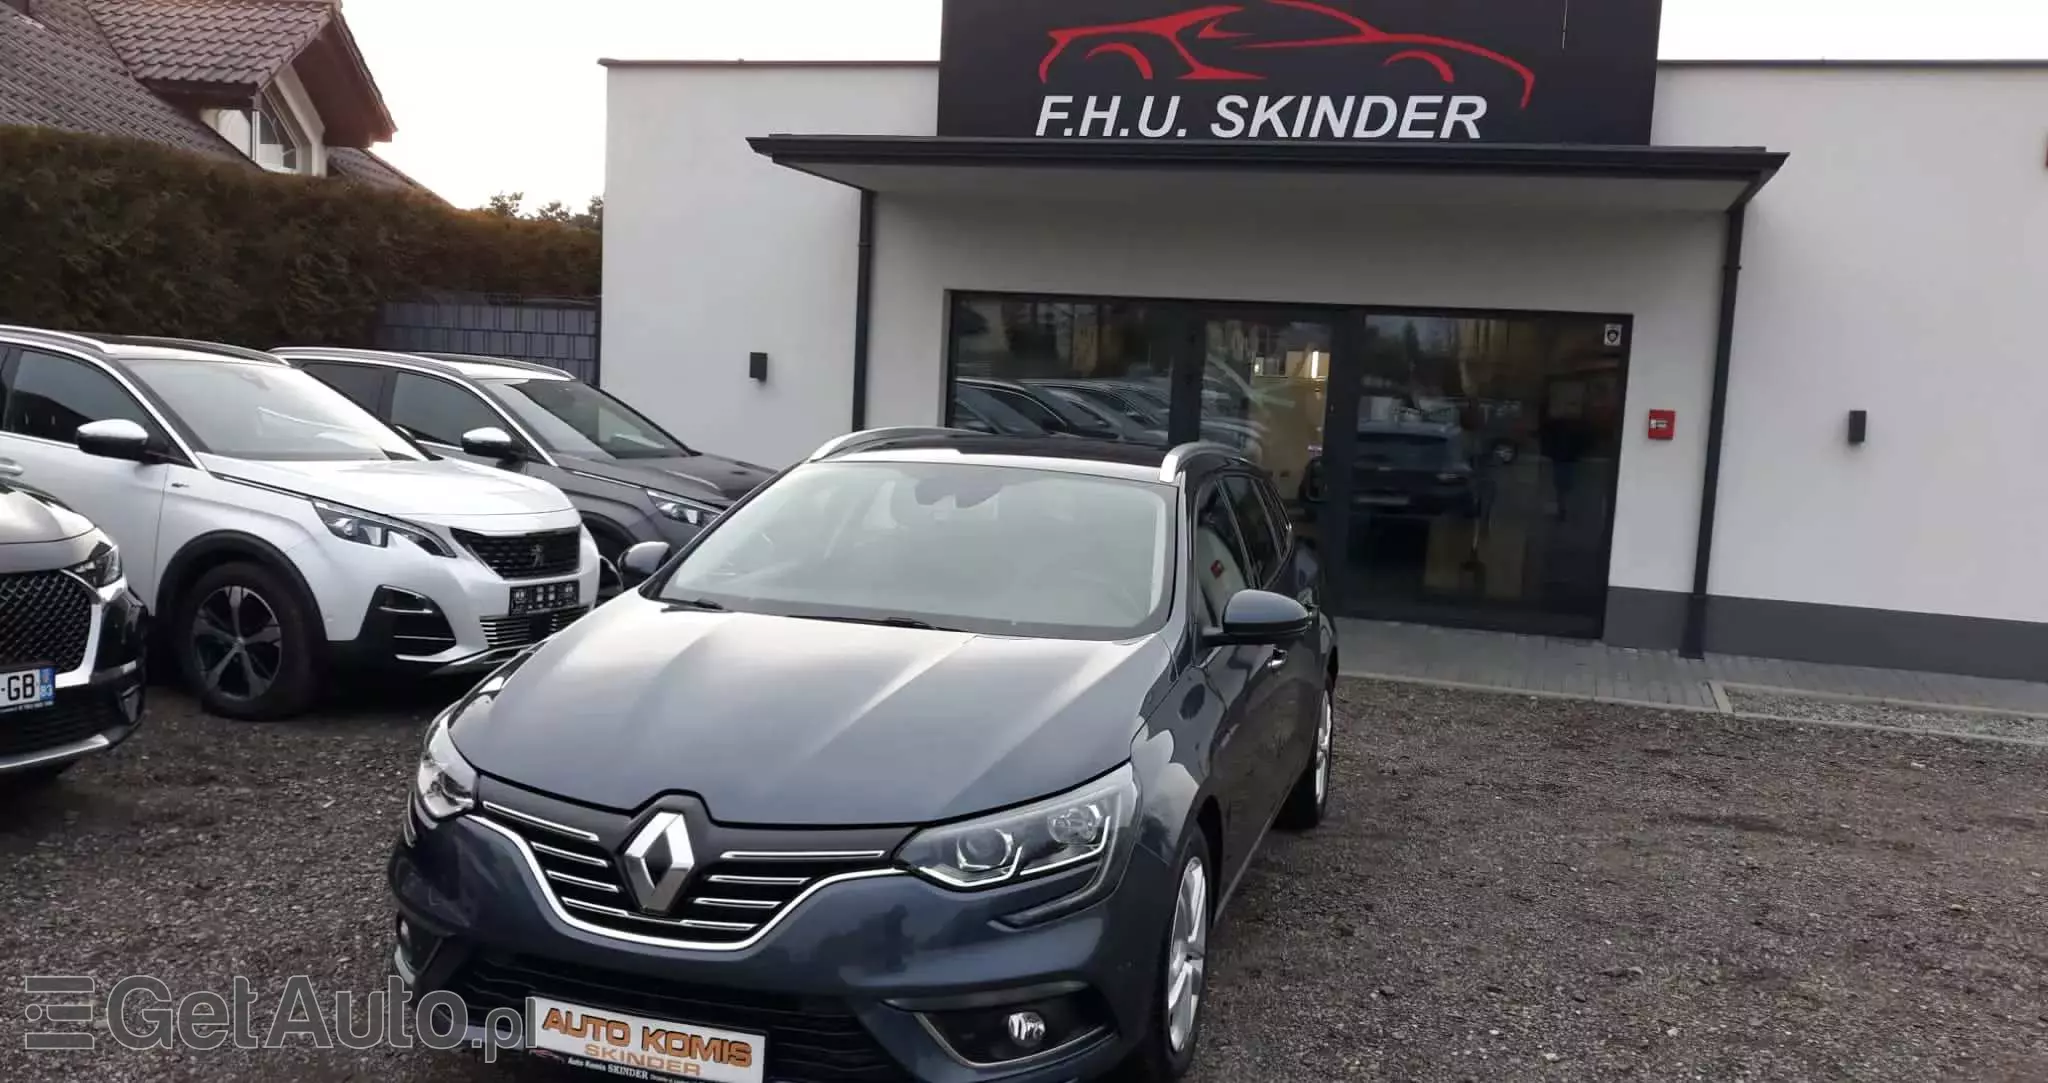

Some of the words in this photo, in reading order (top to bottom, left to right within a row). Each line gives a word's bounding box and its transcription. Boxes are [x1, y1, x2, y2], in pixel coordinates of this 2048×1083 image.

[1035, 95, 1187, 137] F.H.U.
[1210, 95, 1488, 139] SKINDER
[543, 1008, 630, 1046] AUTO
[641, 1026, 752, 1067] KOMIS
[584, 1043, 701, 1076] SKINDER
[607, 1064, 649, 1080] SKINDER
